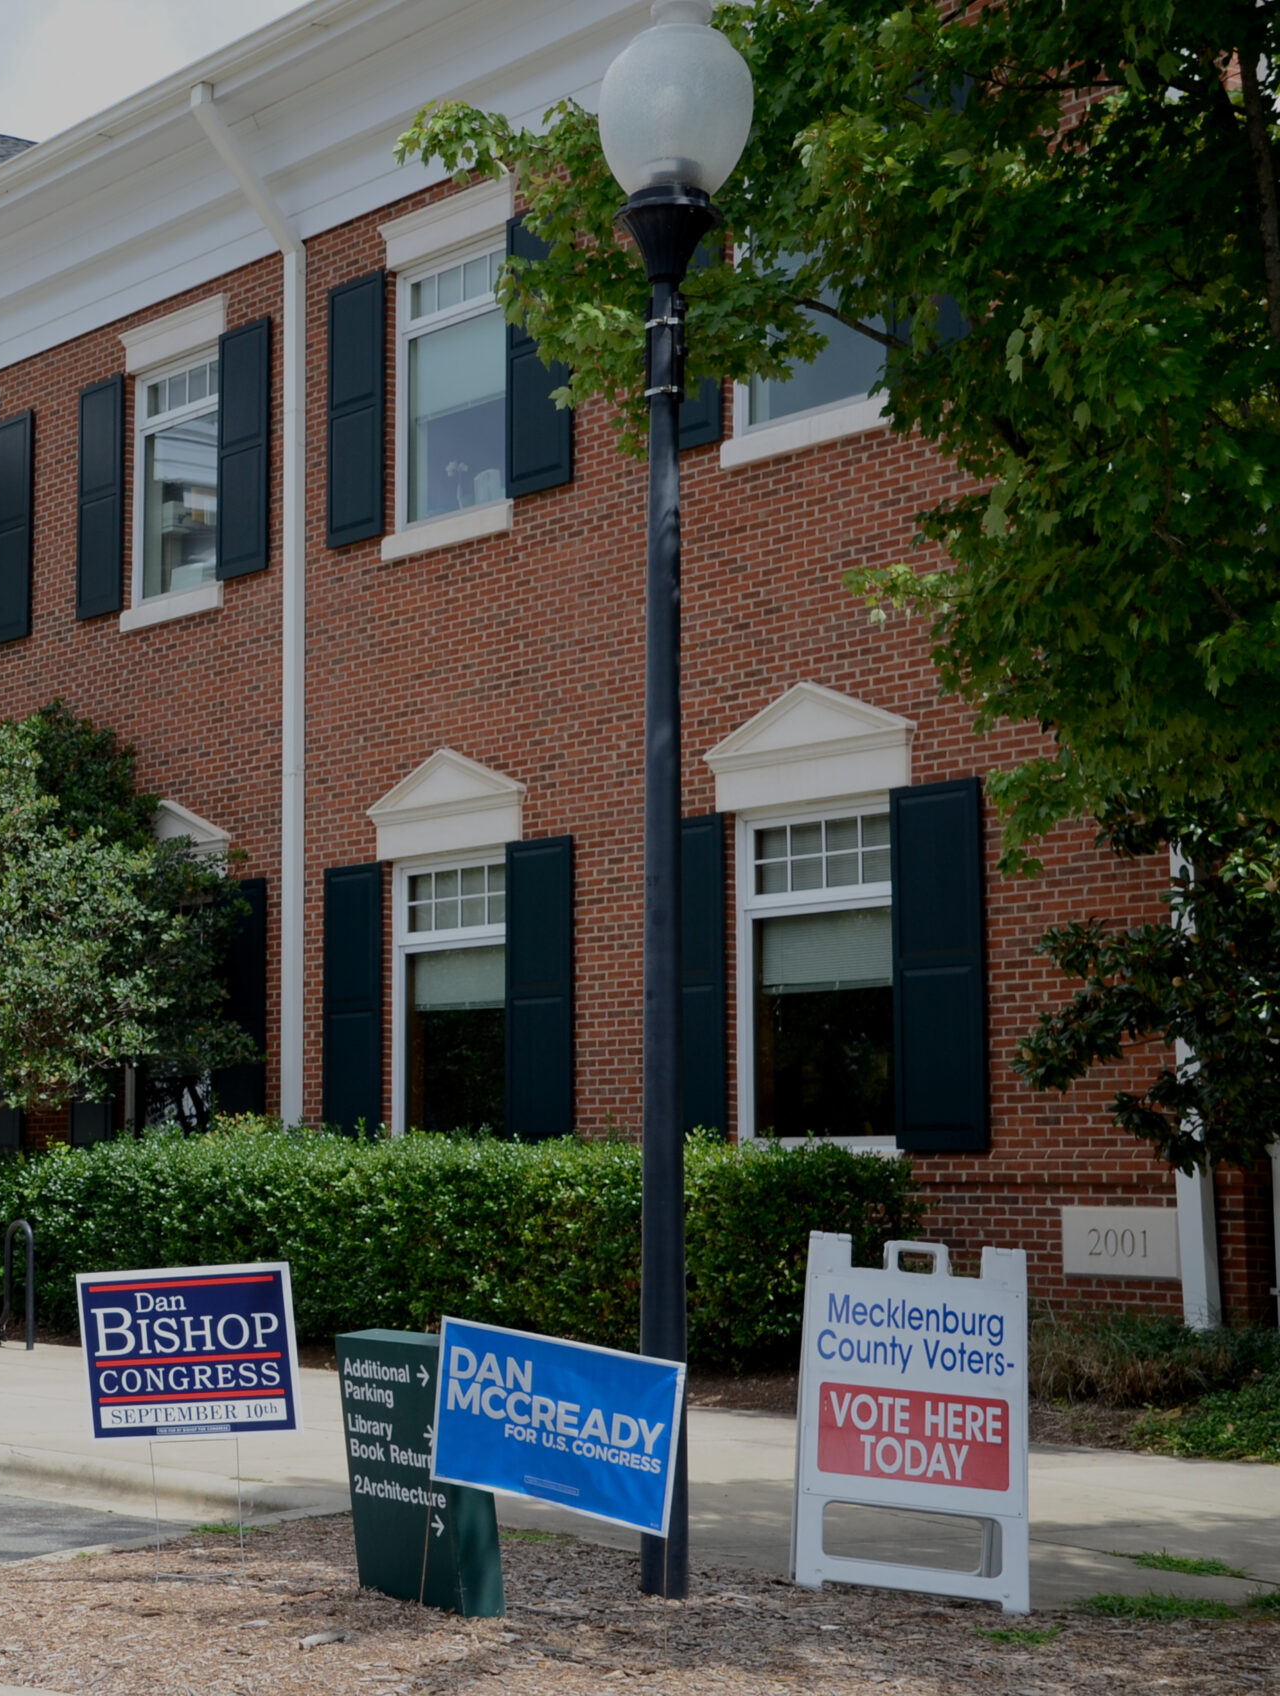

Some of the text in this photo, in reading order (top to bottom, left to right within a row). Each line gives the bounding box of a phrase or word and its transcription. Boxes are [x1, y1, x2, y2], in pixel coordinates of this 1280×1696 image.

[1088, 1228, 1148, 1258] 2001
[134, 1292, 187, 1313] Dan
[827, 1293, 1004, 1347] Mecklenburg
[90, 1307, 279, 1357] BISHOP
[449, 1345, 533, 1393] DAN
[817, 1328, 1015, 1377] County Voters-
[99, 1362, 281, 1394] CONGRESS
[343, 1357, 411, 1384] Additional
[344, 1380, 394, 1408] Parking
[111, 1402, 278, 1425] SEPTEMBER 10th
[347, 1413, 393, 1441] Library
[446, 1378, 665, 1455] MCCREADY
[829, 1391, 1003, 1444] VOTE HERE
[350, 1438, 385, 1462] Book
[504, 1423, 662, 1474] FOR U.S. CONGRESS
[860, 1434, 969, 1481] TODAY
[354, 1474, 447, 1509] 2Architecture
